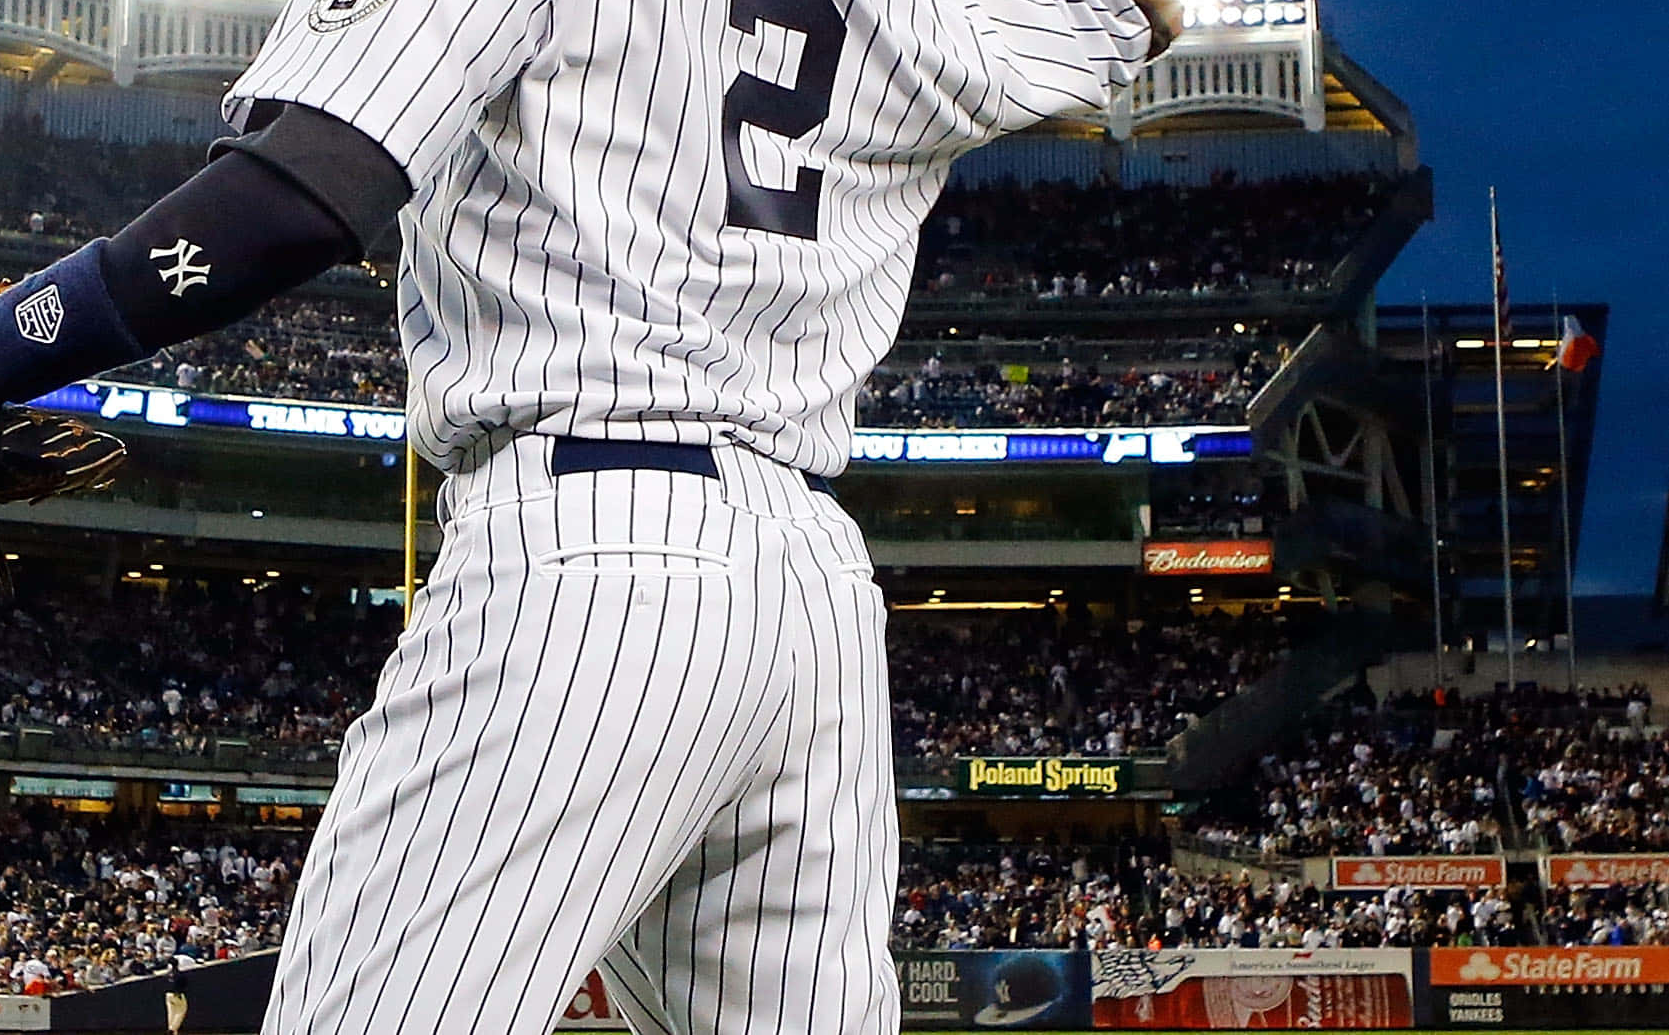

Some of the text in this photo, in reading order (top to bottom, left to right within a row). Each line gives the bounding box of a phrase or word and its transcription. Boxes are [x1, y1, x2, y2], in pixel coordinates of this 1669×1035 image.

[248, 404, 405, 440] THANK YOU
[1144, 549, 1269, 572] Budweiser
[969, 758, 1120, 793] Poland Spring
[1449, 992, 1502, 1007] ORIOLES
[1449, 1007, 1504, 1022] YANKEES
